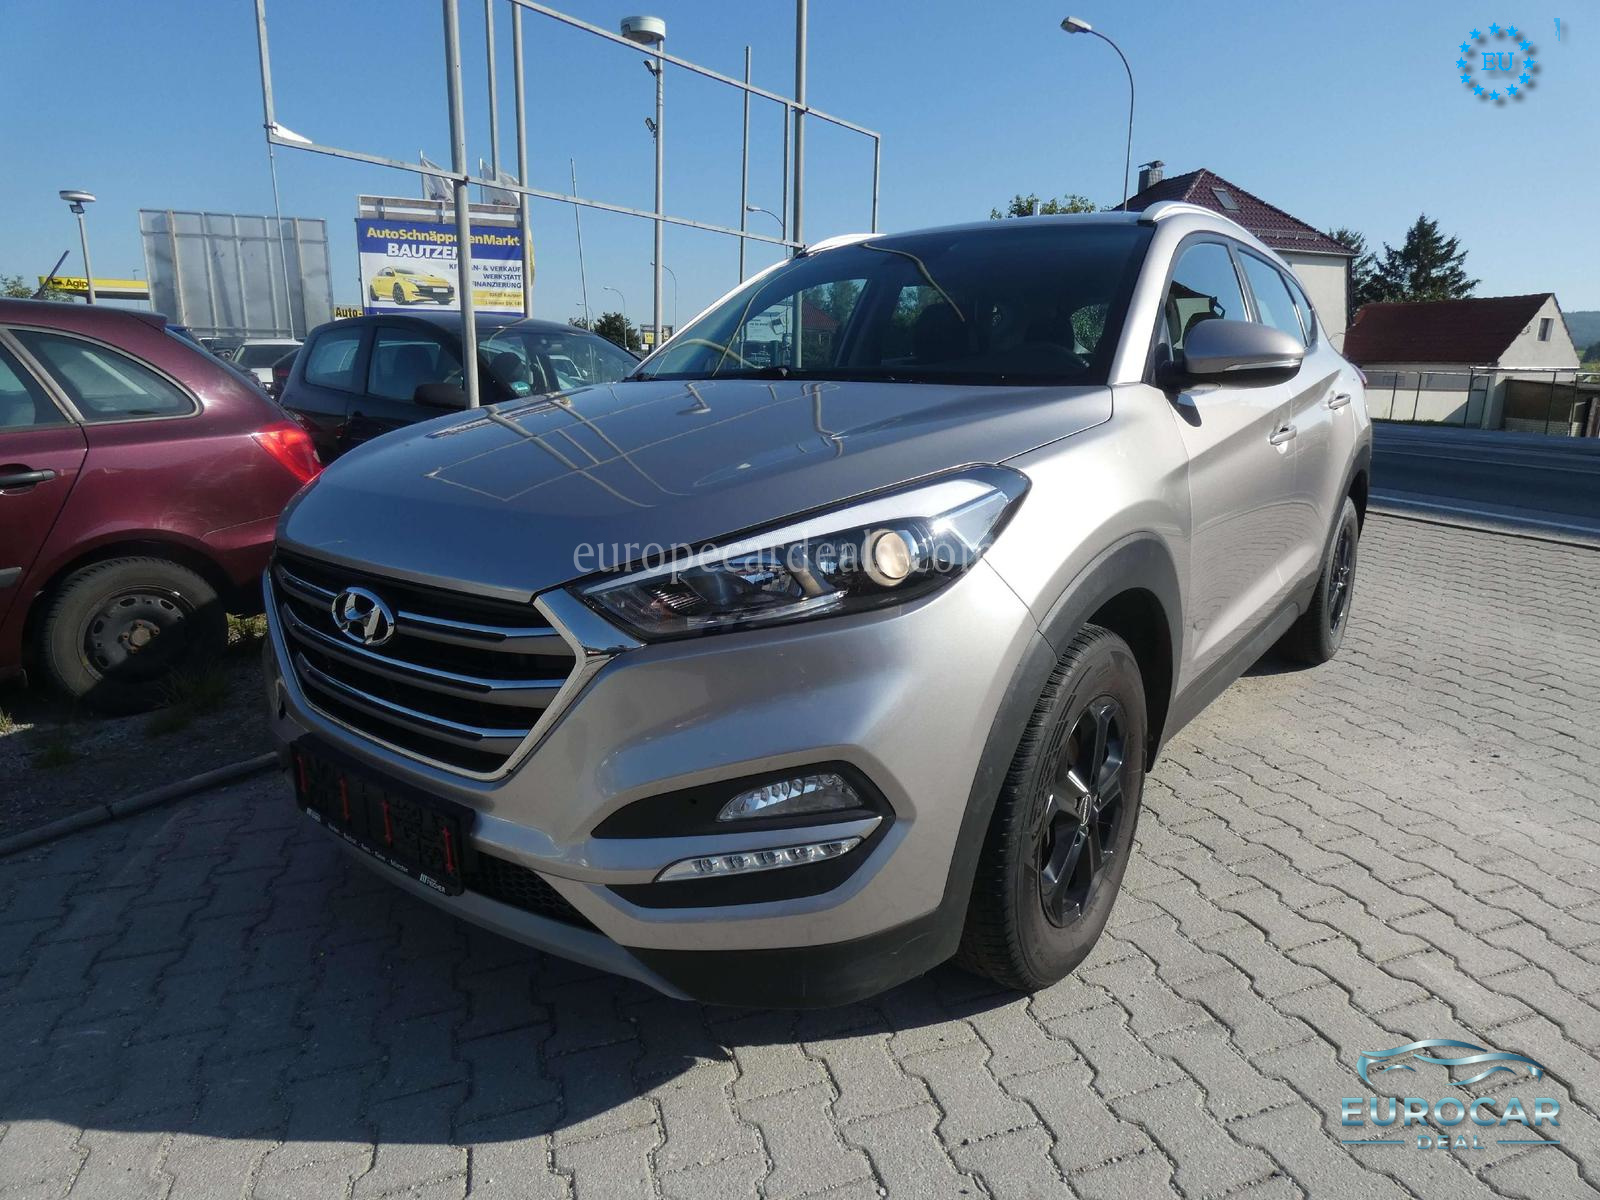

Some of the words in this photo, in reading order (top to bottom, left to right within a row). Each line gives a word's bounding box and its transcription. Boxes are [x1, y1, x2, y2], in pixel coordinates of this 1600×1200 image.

[367, 227, 520, 246] AutoSchnäppenMarkt
[490, 265, 521, 273] VERKAUF
[482, 273, 522, 281] WERKSTATT
[66, 279, 89, 288] Agip
